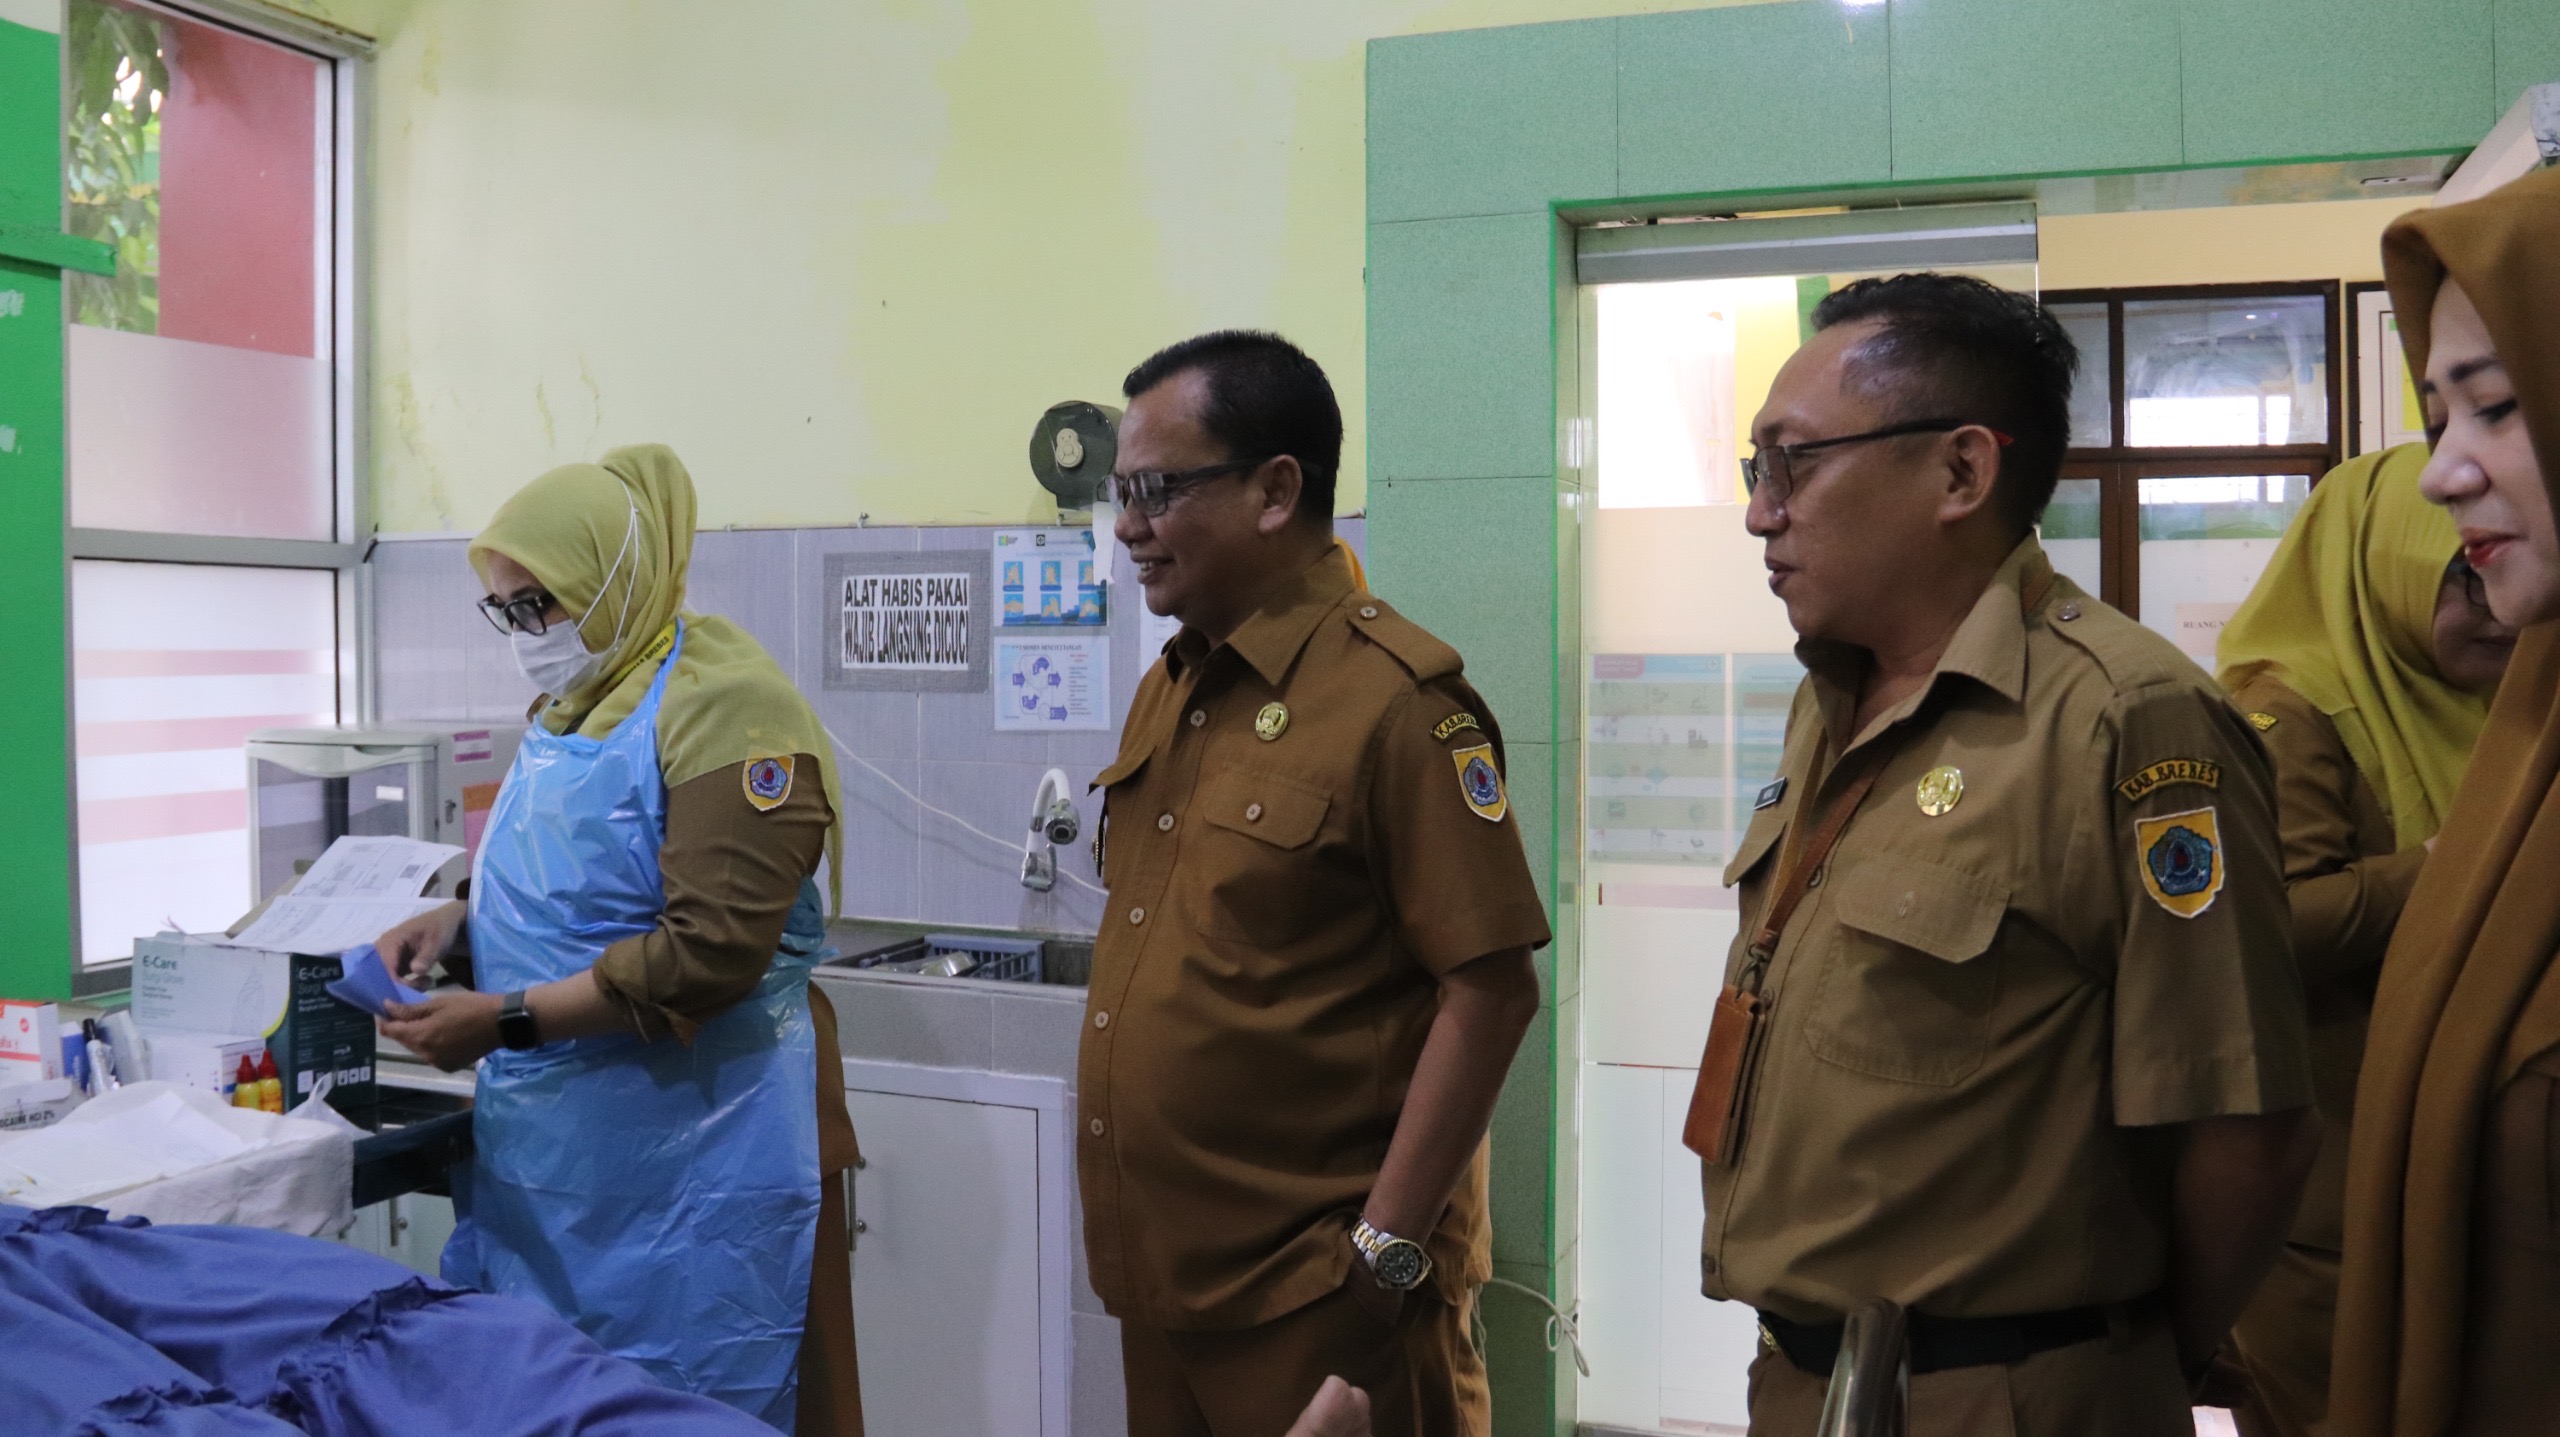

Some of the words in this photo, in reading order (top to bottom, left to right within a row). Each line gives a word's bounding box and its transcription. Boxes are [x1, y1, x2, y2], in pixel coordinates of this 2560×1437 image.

[844, 579, 878, 607] ALAT
[881, 578, 923, 607] HABIS
[927, 577, 968, 607] PAKAI
[844, 610, 874, 664] WAJIB
[877, 609, 931, 665] LANGSUNG
[934, 609, 968, 665] DICUCI
[2156, 762, 2216, 783] BREBES
[142, 954, 178, 971] E-Care
[298, 965, 340, 981] E-Care
